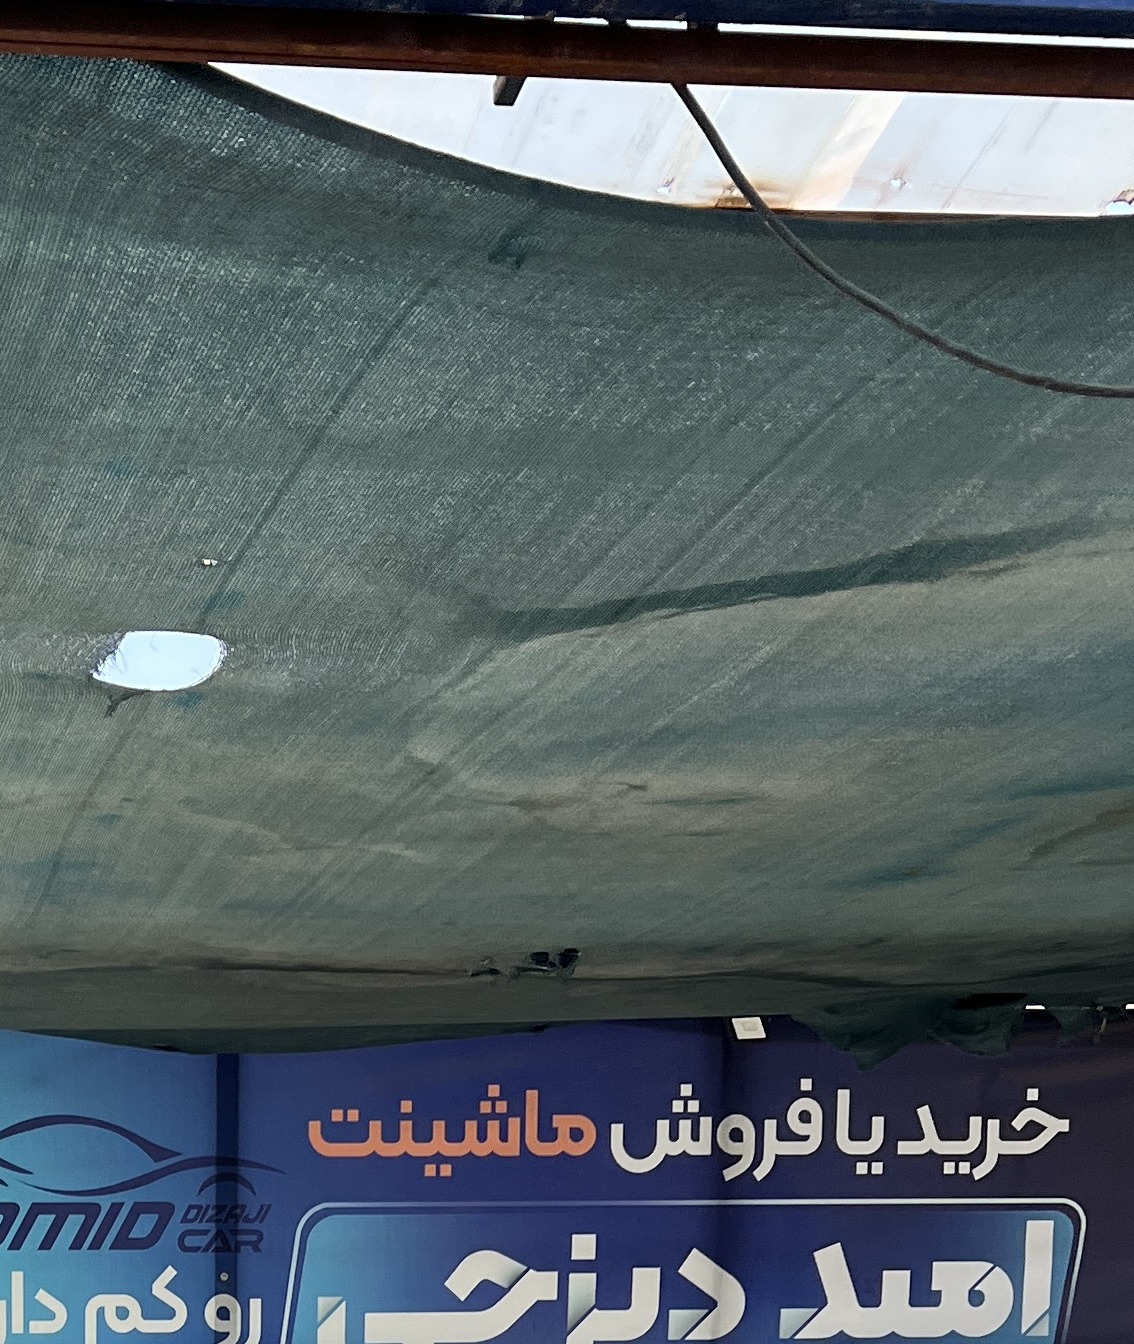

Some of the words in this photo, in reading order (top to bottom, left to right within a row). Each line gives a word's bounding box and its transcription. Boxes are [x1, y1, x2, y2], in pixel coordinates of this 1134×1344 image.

[307, 1083, 598, 1178] ماشینت
[609, 1077, 824, 1182] فروش
[834, 1086, 886, 1176] یا
[896, 1088, 1072, 1182] خرید
[176, 1228, 265, 1254] CAR
[179, 1203, 271, 1225] DIZAJI
